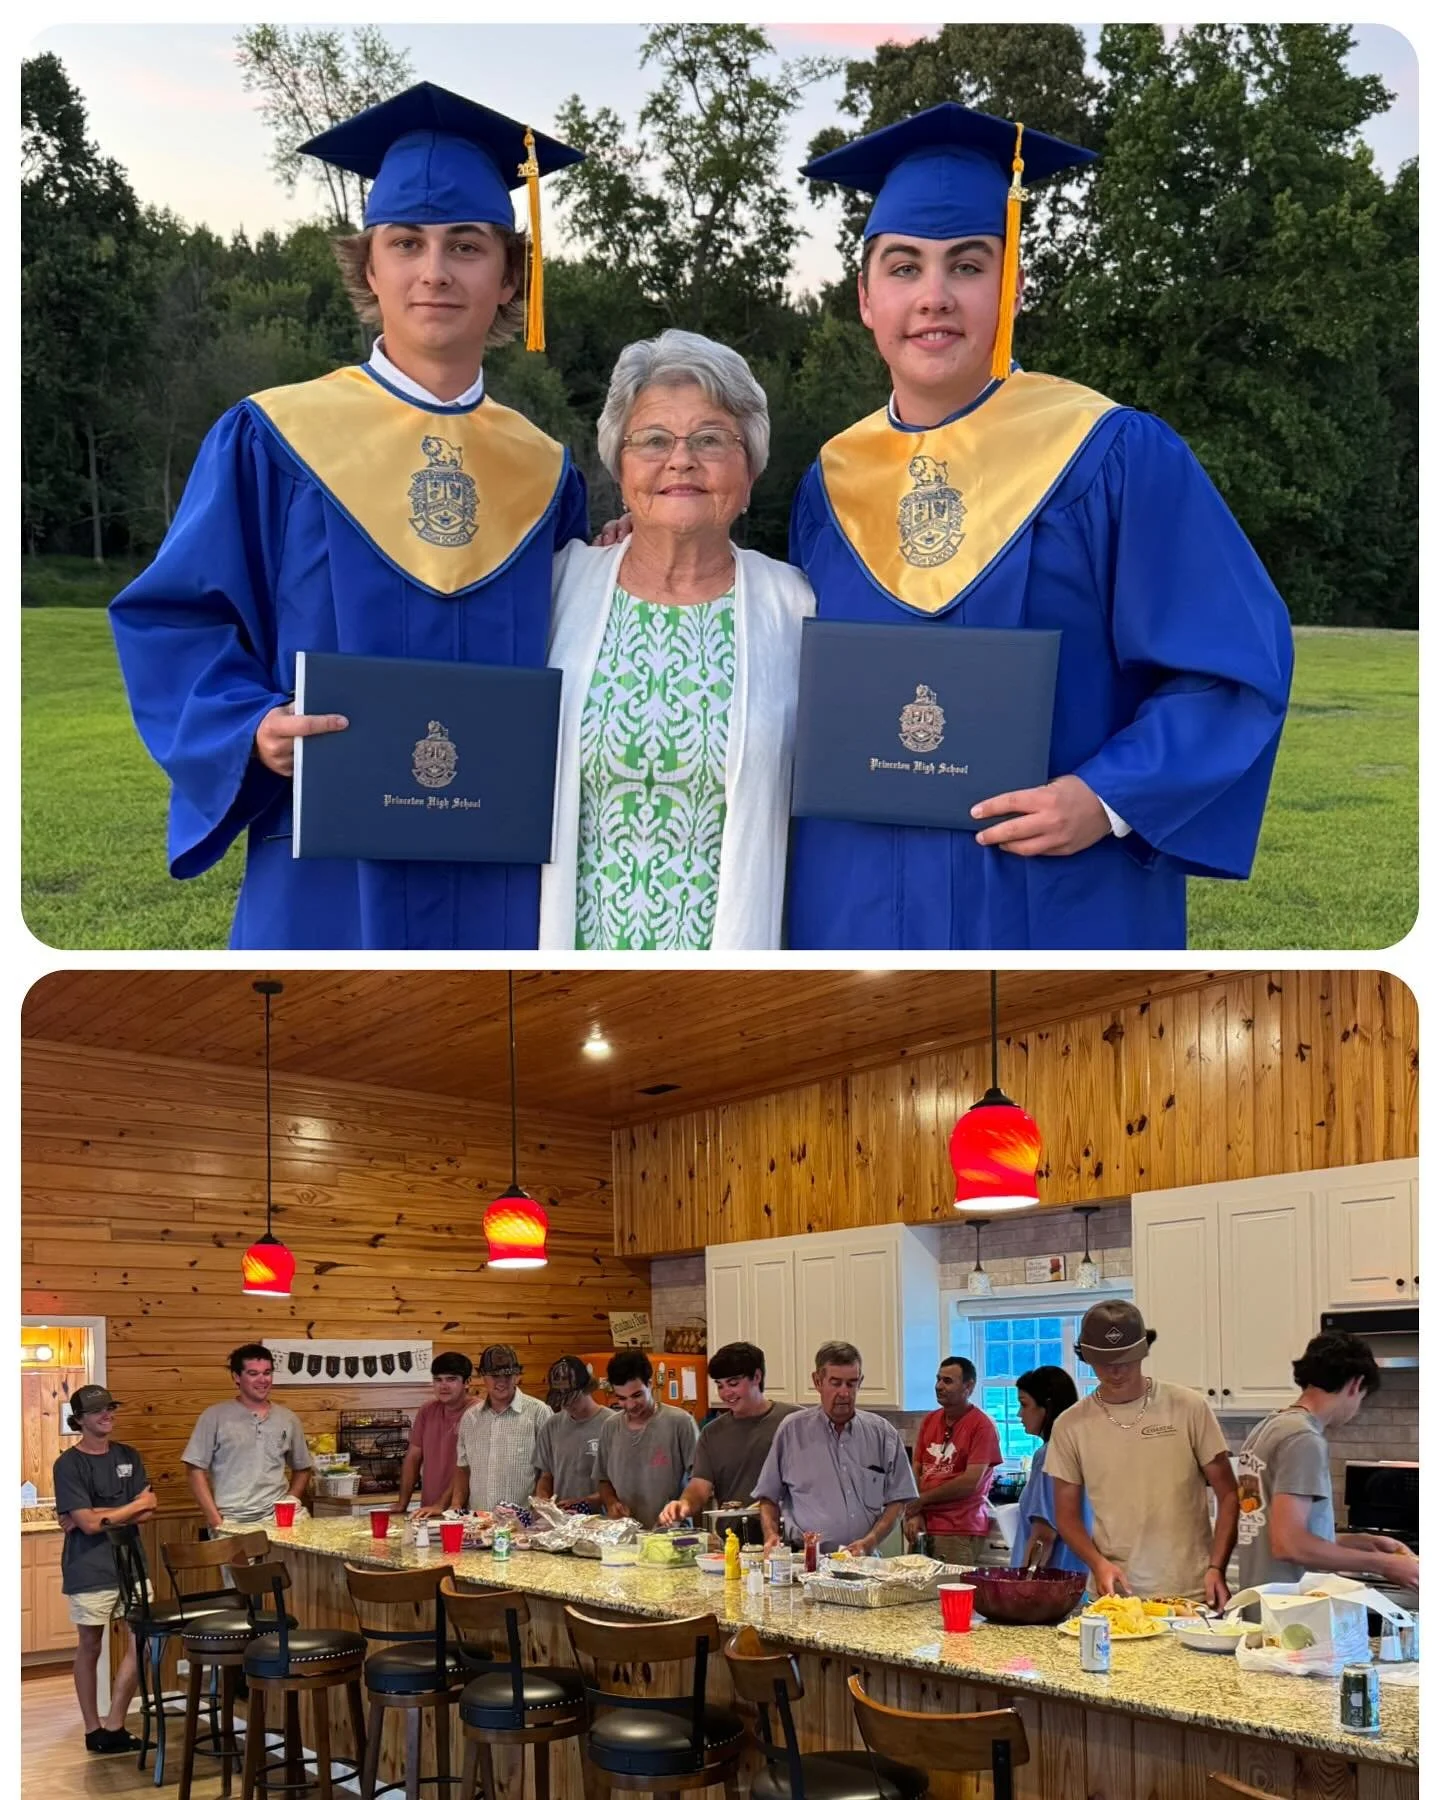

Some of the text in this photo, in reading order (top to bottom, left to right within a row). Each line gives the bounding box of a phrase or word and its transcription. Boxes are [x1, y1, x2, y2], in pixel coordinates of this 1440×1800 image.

[870, 758, 969, 777] Princeton High School
[383, 794, 481, 810] Princeton High School
